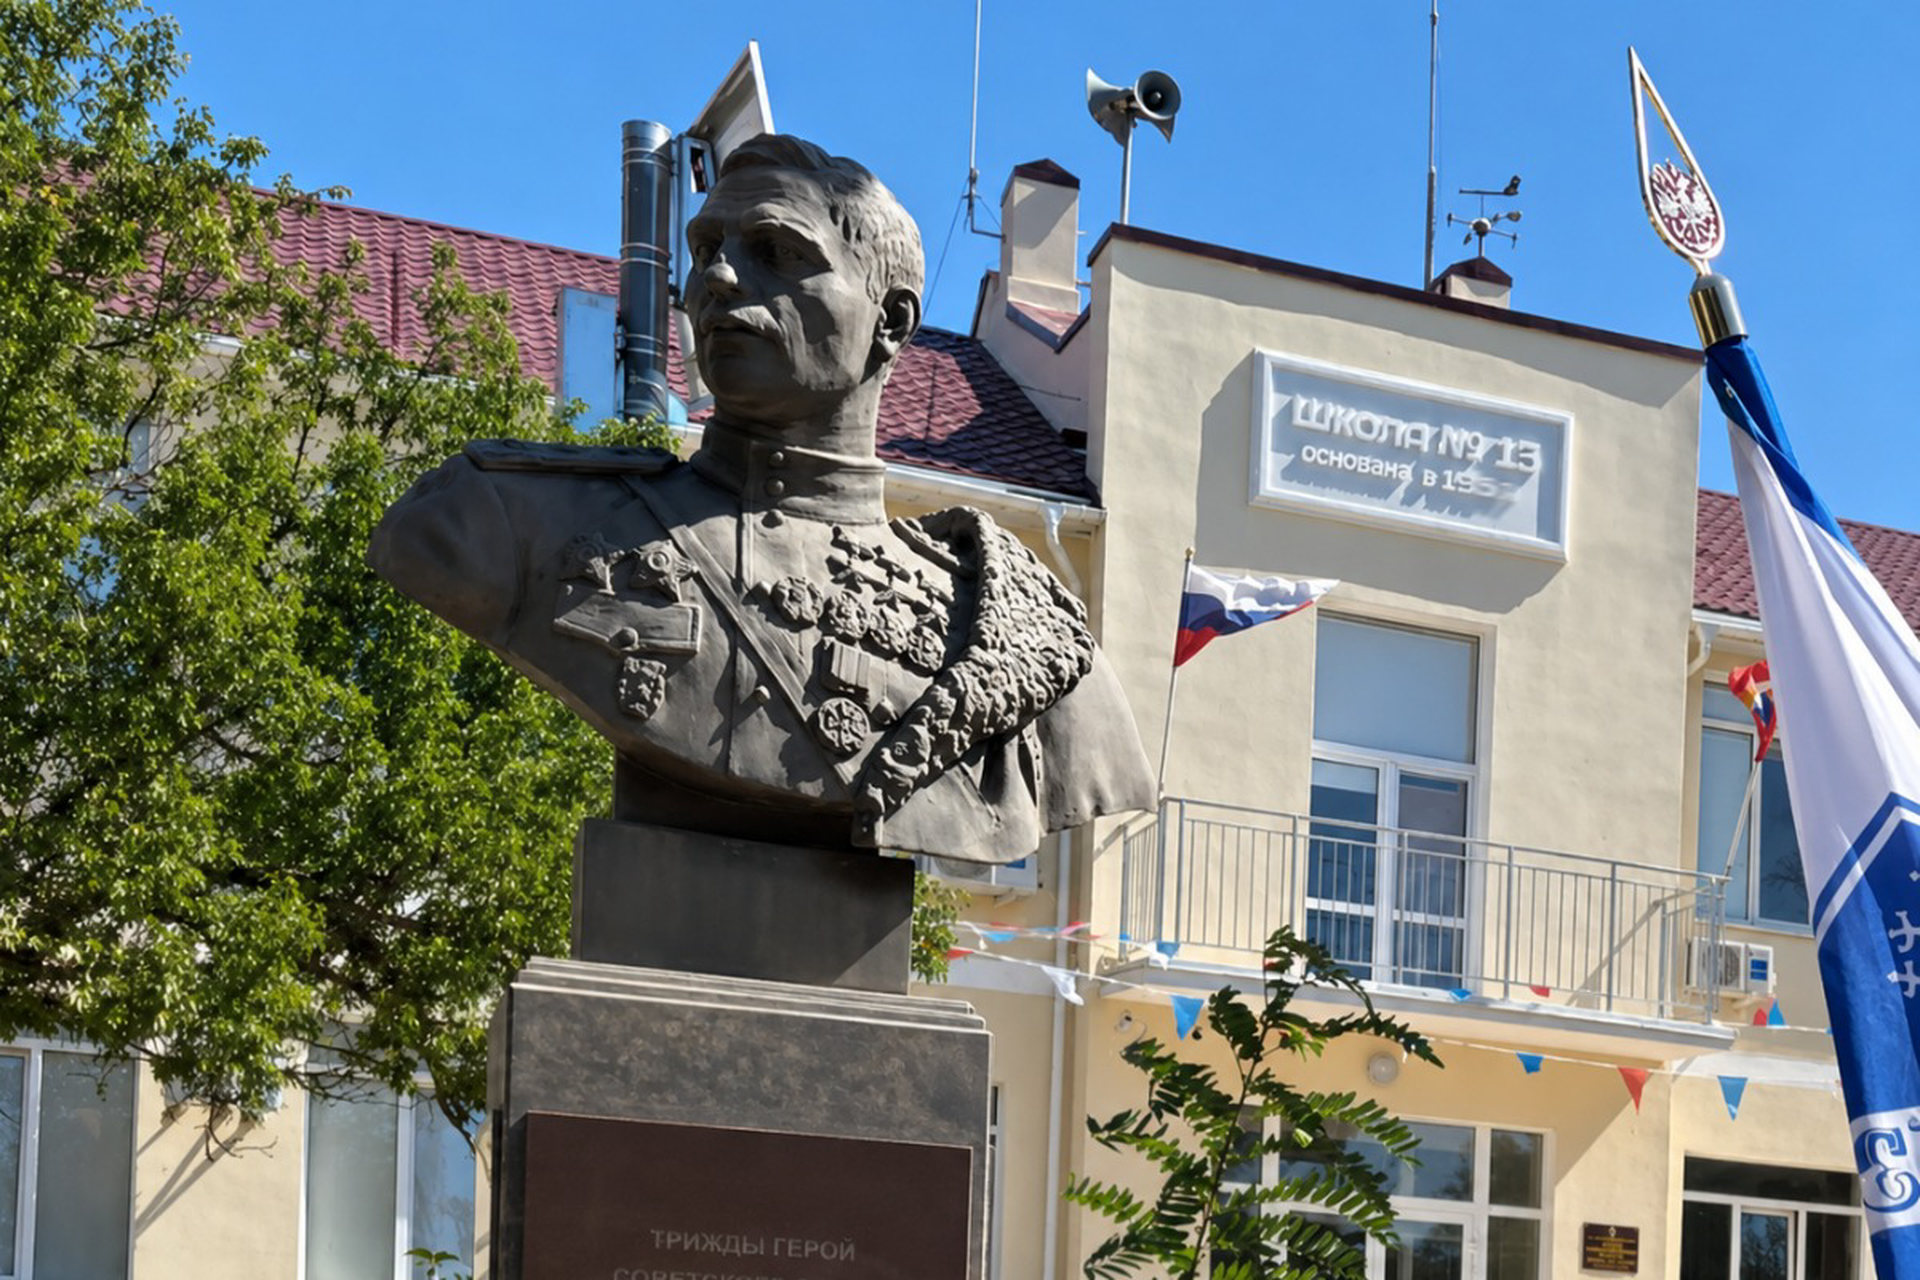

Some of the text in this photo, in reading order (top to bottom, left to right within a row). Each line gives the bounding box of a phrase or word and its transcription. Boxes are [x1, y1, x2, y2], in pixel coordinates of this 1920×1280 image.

[1292, 393, 1431, 452] ШКОЛА
[1439, 424, 1484, 462] №
[1301, 445, 1521, 504] основана в 19
[650, 1229, 856, 1262] ТРИЖДЫ ГЕРОЙ
